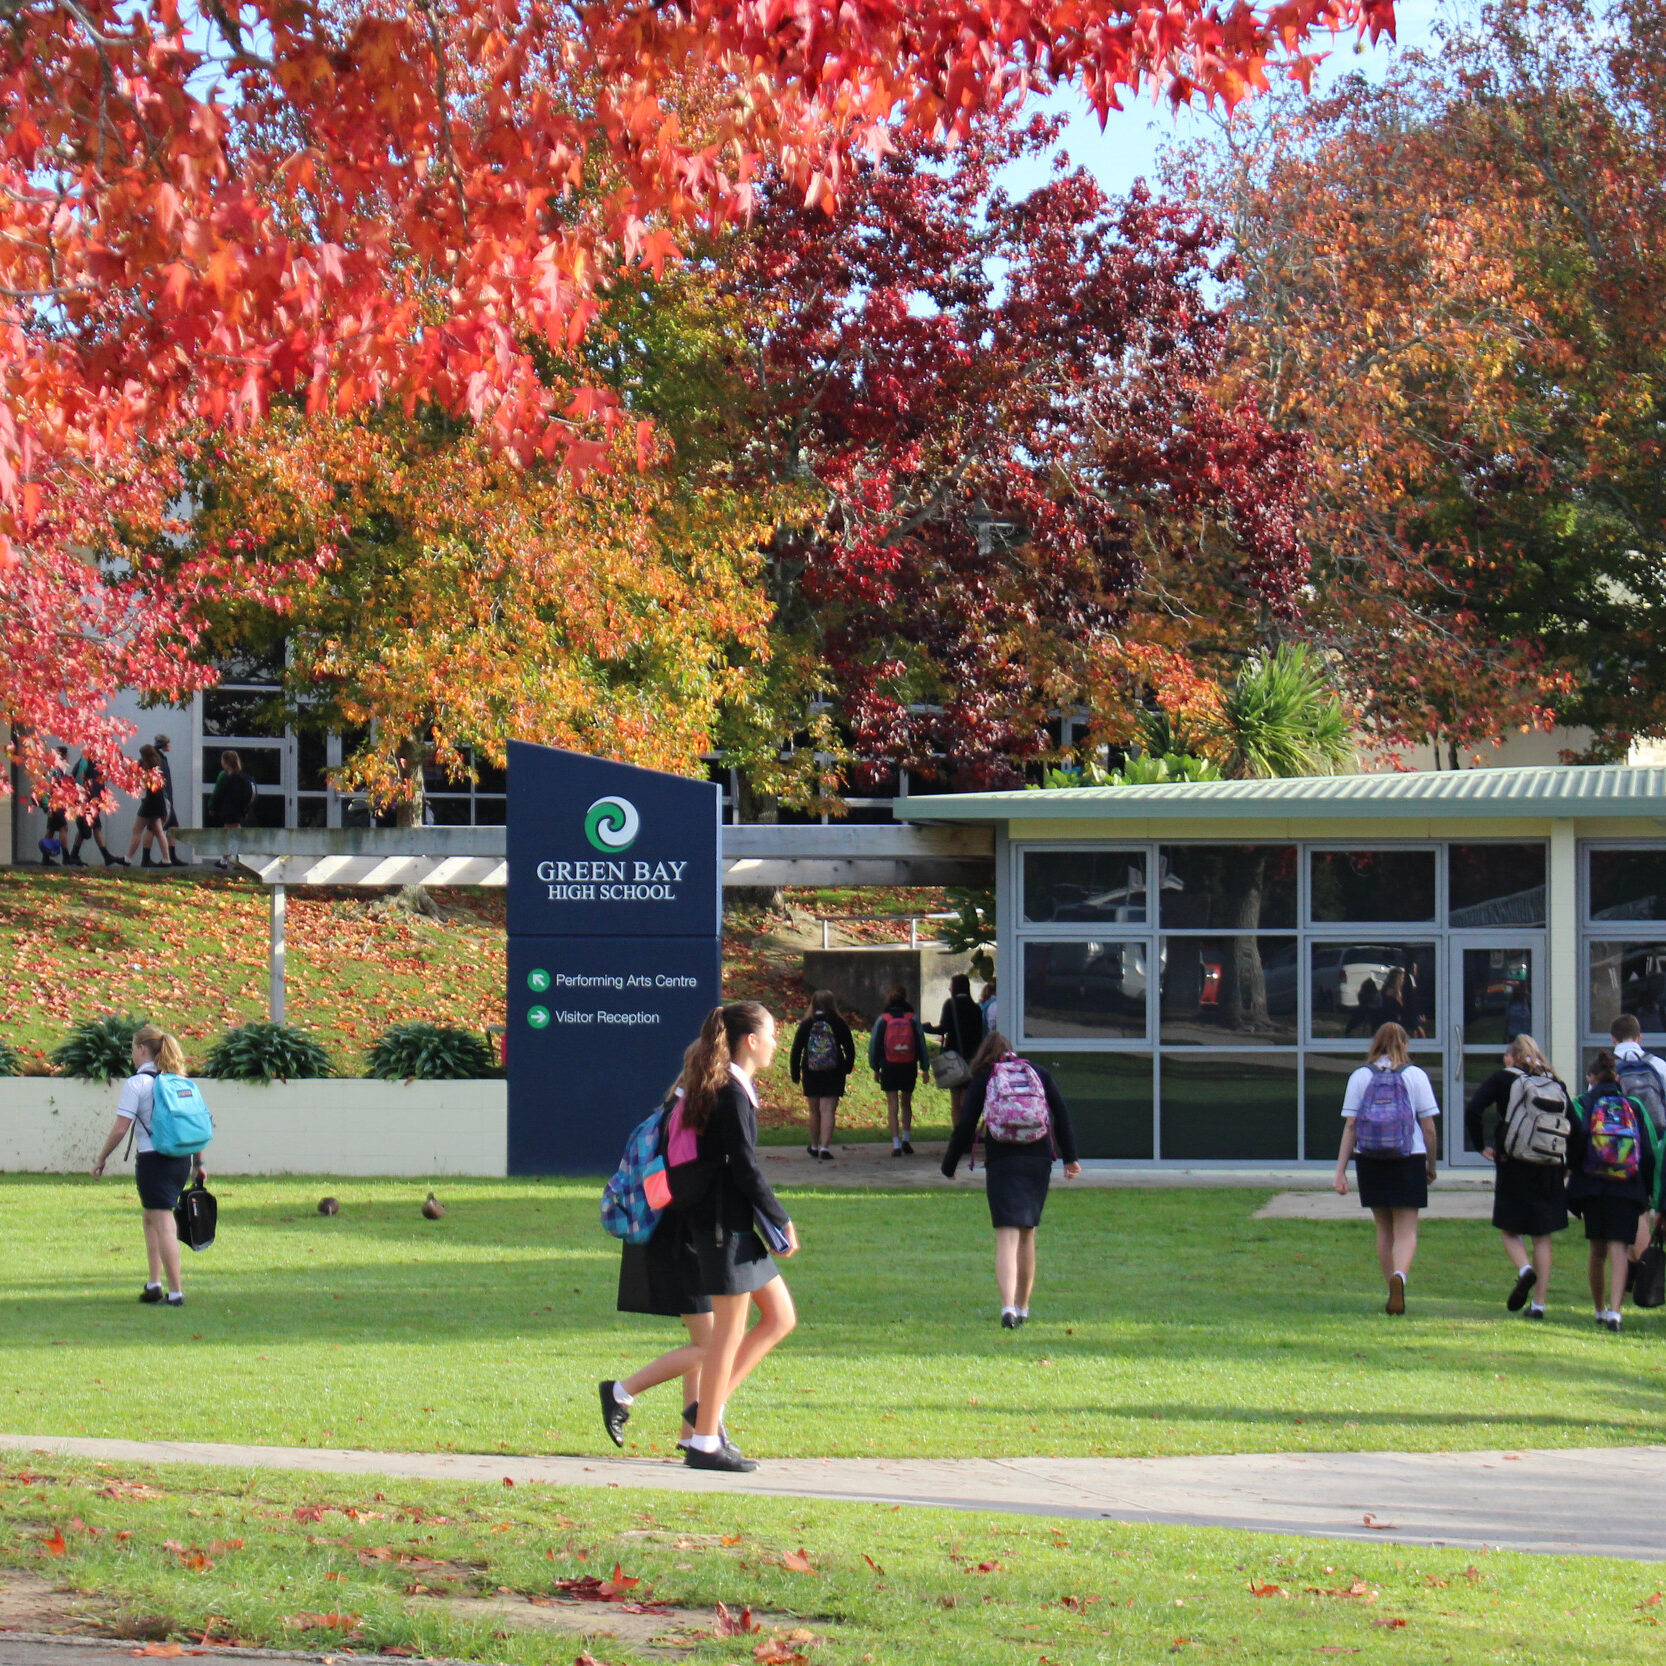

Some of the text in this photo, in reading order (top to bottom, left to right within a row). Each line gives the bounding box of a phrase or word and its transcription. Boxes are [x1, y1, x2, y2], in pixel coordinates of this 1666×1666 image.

[536, 861, 687, 882] GREEN BAY
[547, 884, 675, 900] HIGH SCHOOL
[556, 973, 697, 990] Performing Arts Centre
[555, 1010, 660, 1026] Visitor Reception
